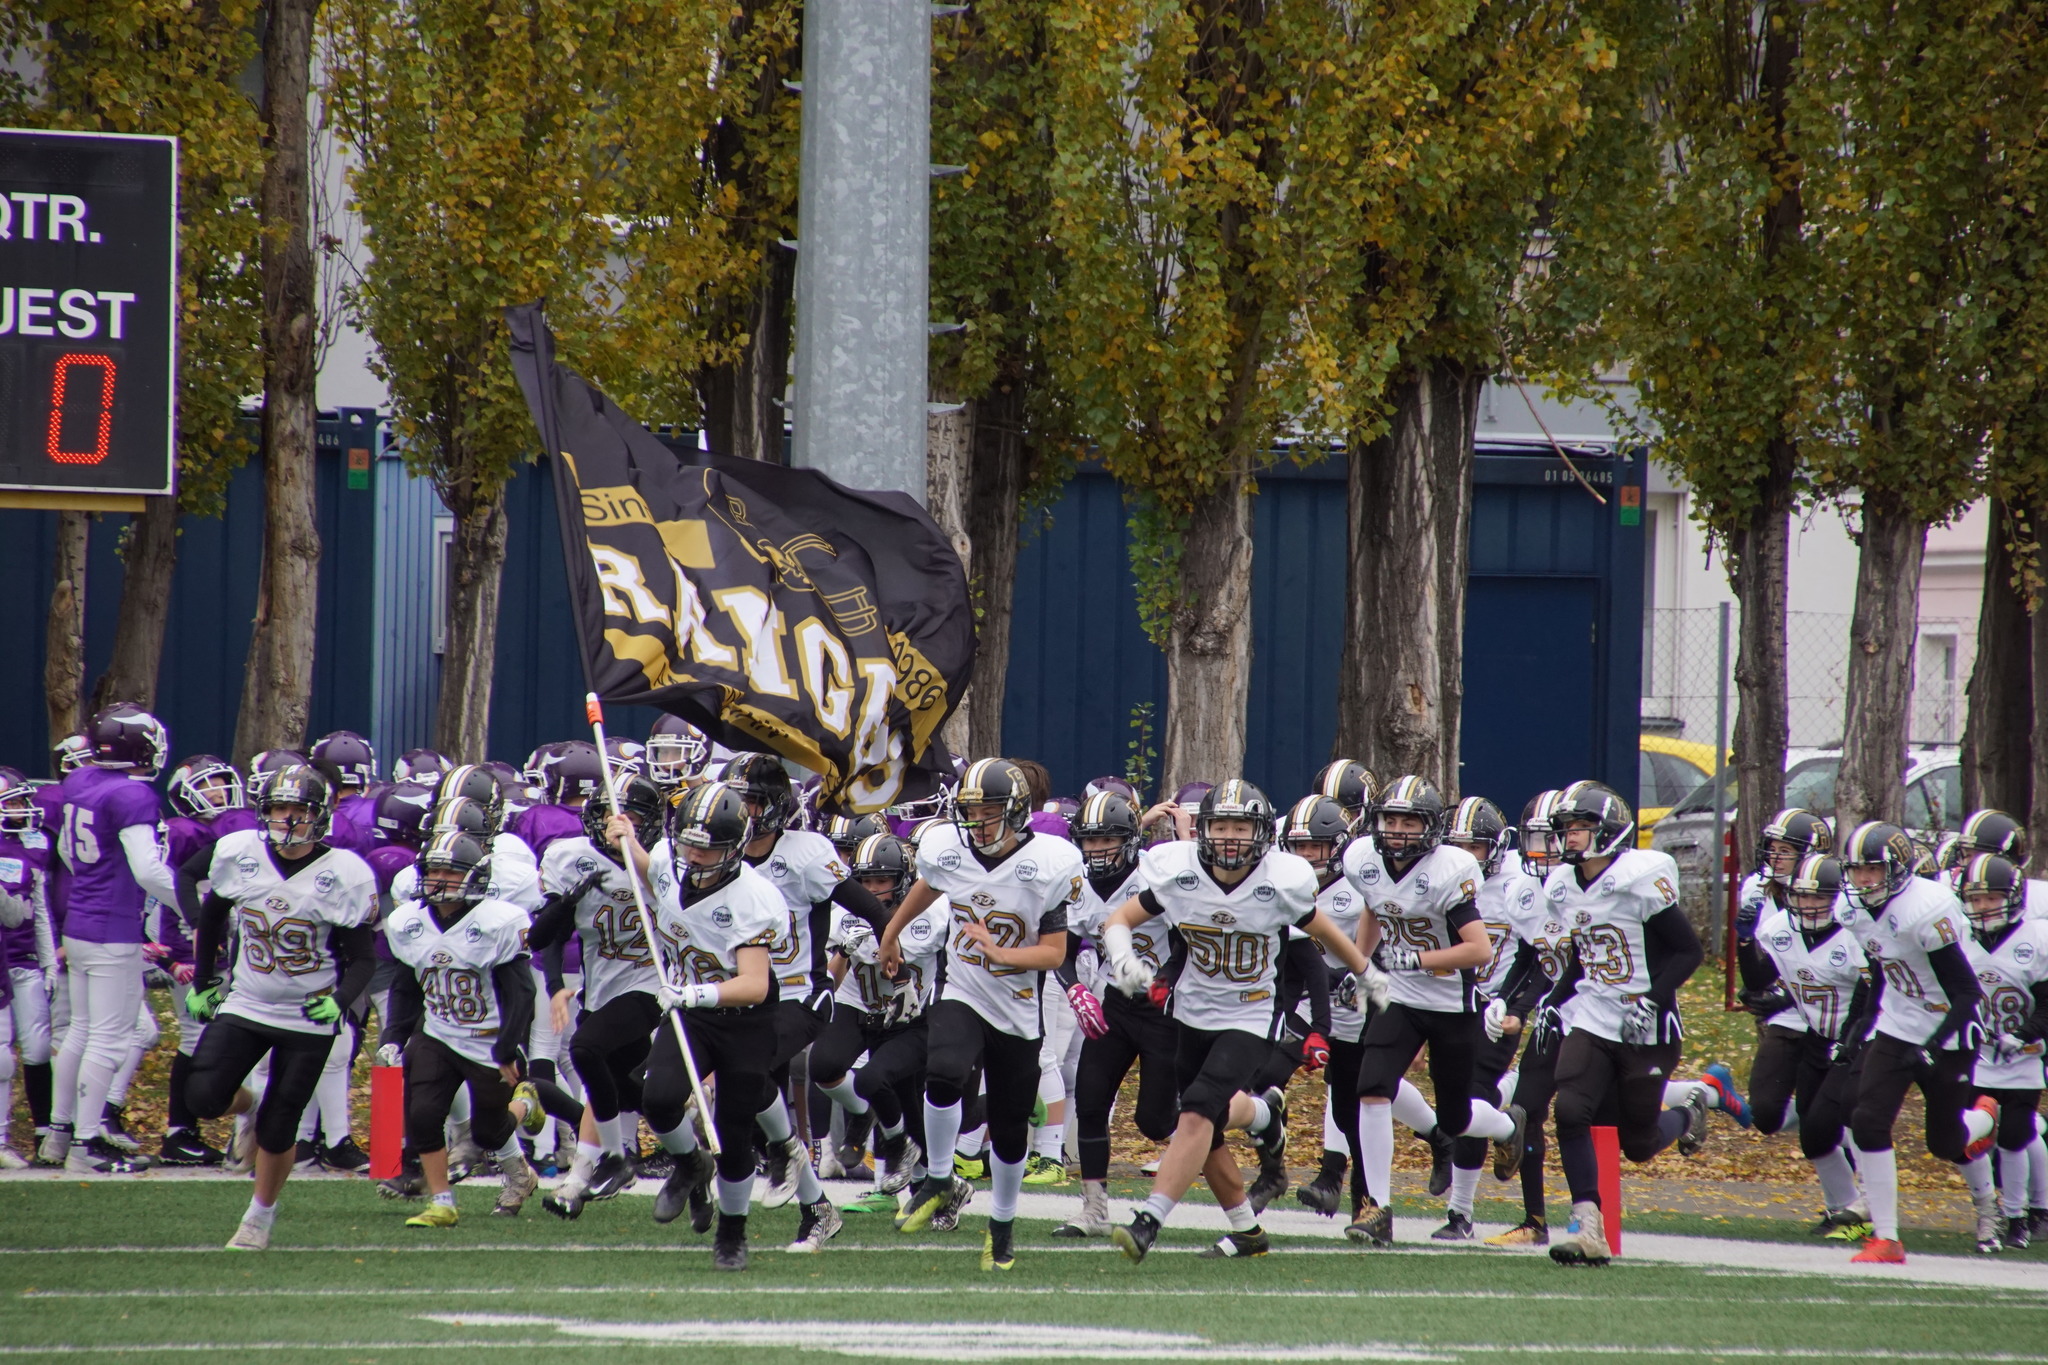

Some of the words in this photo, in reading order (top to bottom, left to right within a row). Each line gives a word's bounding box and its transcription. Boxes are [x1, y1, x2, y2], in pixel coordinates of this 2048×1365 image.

[48, 354, 116, 465] 0
[893, 641, 944, 711] 1986
[238, 907, 323, 978] 69
[593, 904, 657, 961] 12
[1179, 921, 1272, 984] 50
[417, 967, 488, 1026] 48
